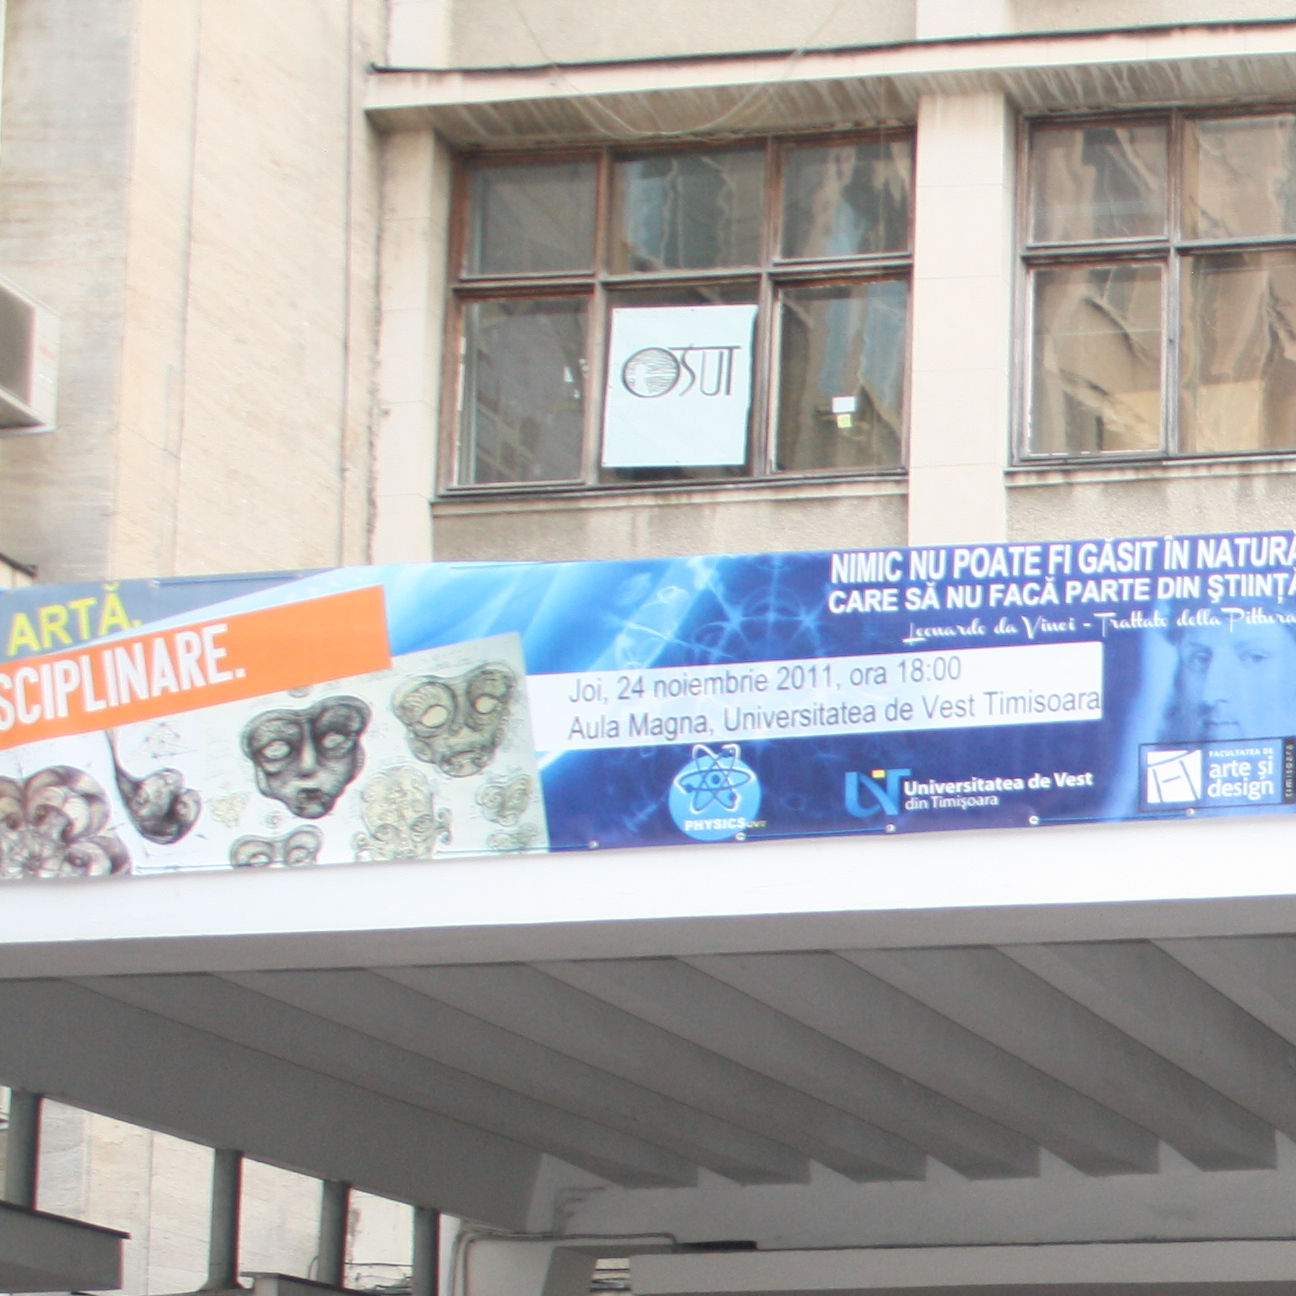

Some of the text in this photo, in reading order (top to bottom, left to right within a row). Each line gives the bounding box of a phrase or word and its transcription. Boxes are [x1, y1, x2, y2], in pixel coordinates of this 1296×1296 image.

[831, 550, 904, 584] NIMIC
[909, 549, 946, 581] NU
[953, 544, 1043, 579] POATE
[1049, 544, 1072, 575] FI
[1078, 537, 1158, 574] GĂSIT
[1164, 534, 1190, 570] ÎN
[828, 587, 899, 614] CARE
[905, 581, 940, 611] SĂ
[946, 585, 982, 609] NU
[989, 576, 1059, 606] FACĂ
[1065, 577, 1150, 604] PARTE
[1157, 575, 1200, 599] DIN
[8, 581, 143, 657] ARTĂ.
[568, 655, 962, 704] Joi, 24 noiembrie 2011, ora 18:00
[567, 689, 1101, 742] Aula Magna, Universitatea de Vest Timisoara
[904, 771, 1094, 796] Universitatea de Vest
[1209, 759, 1251, 779] arte
[904, 796, 929, 810] din
[1207, 778, 1274, 800] design
[684, 818, 746, 832] PHYSICS
